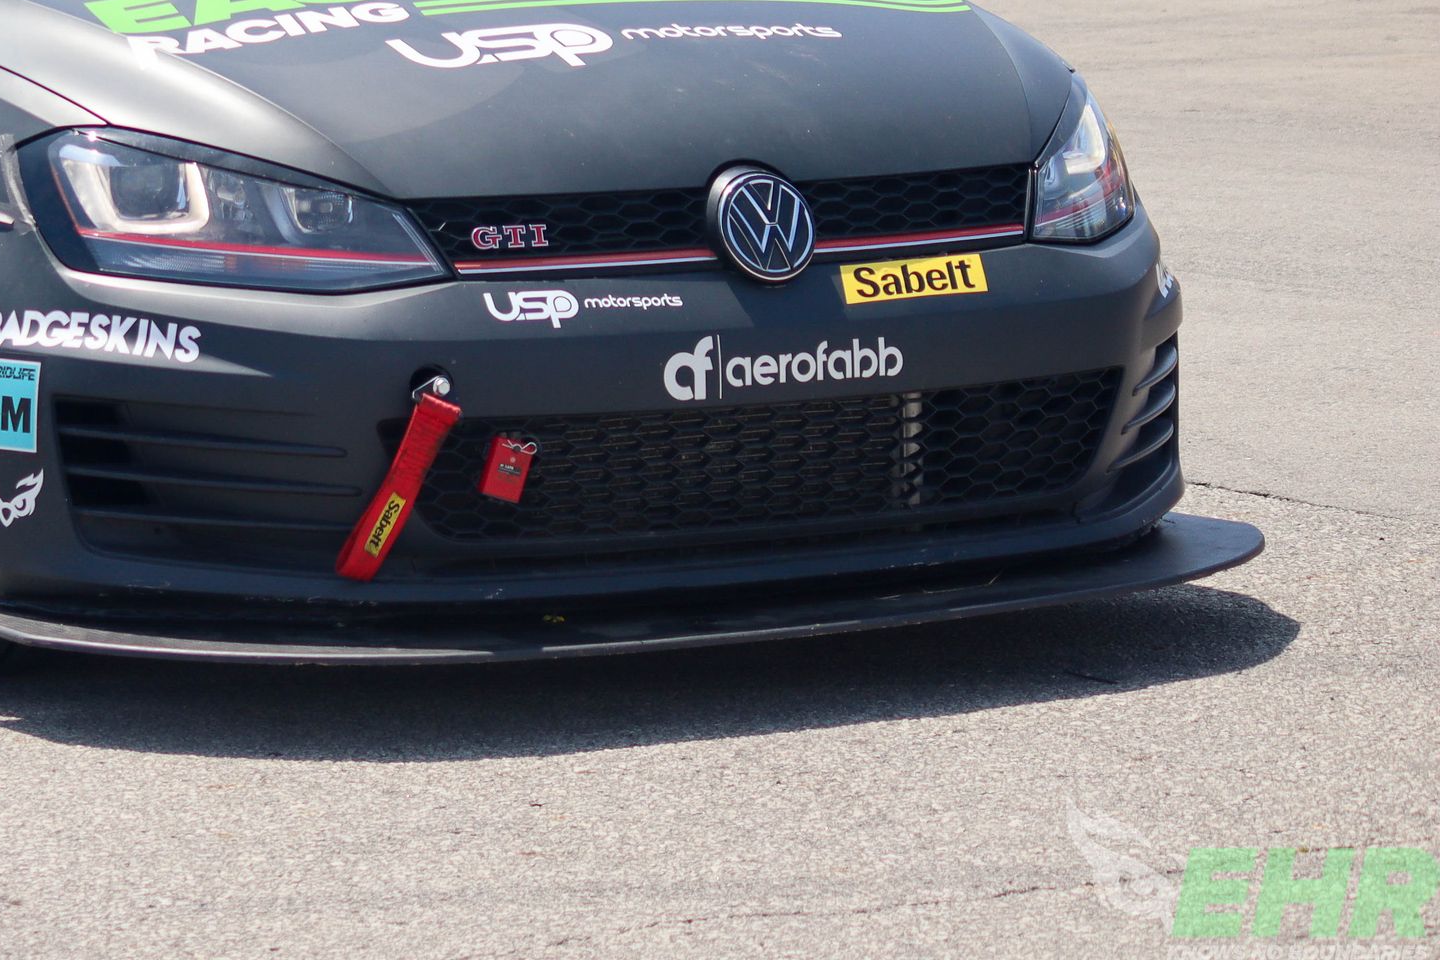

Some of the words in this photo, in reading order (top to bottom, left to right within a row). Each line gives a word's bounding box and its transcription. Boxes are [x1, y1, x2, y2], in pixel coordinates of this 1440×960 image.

[126, 1, 410, 71] RACING
[384, 22, 614, 69] USP
[621, 22, 844, 40] motorsports
[471, 224, 550, 251] GTI
[855, 259, 979, 299] Sabelt
[483, 289, 580, 329] USP
[584, 292, 684, 310] motorsports
[725, 336, 905, 387] aerofabb
[368, 499, 401, 549] Sabelt
